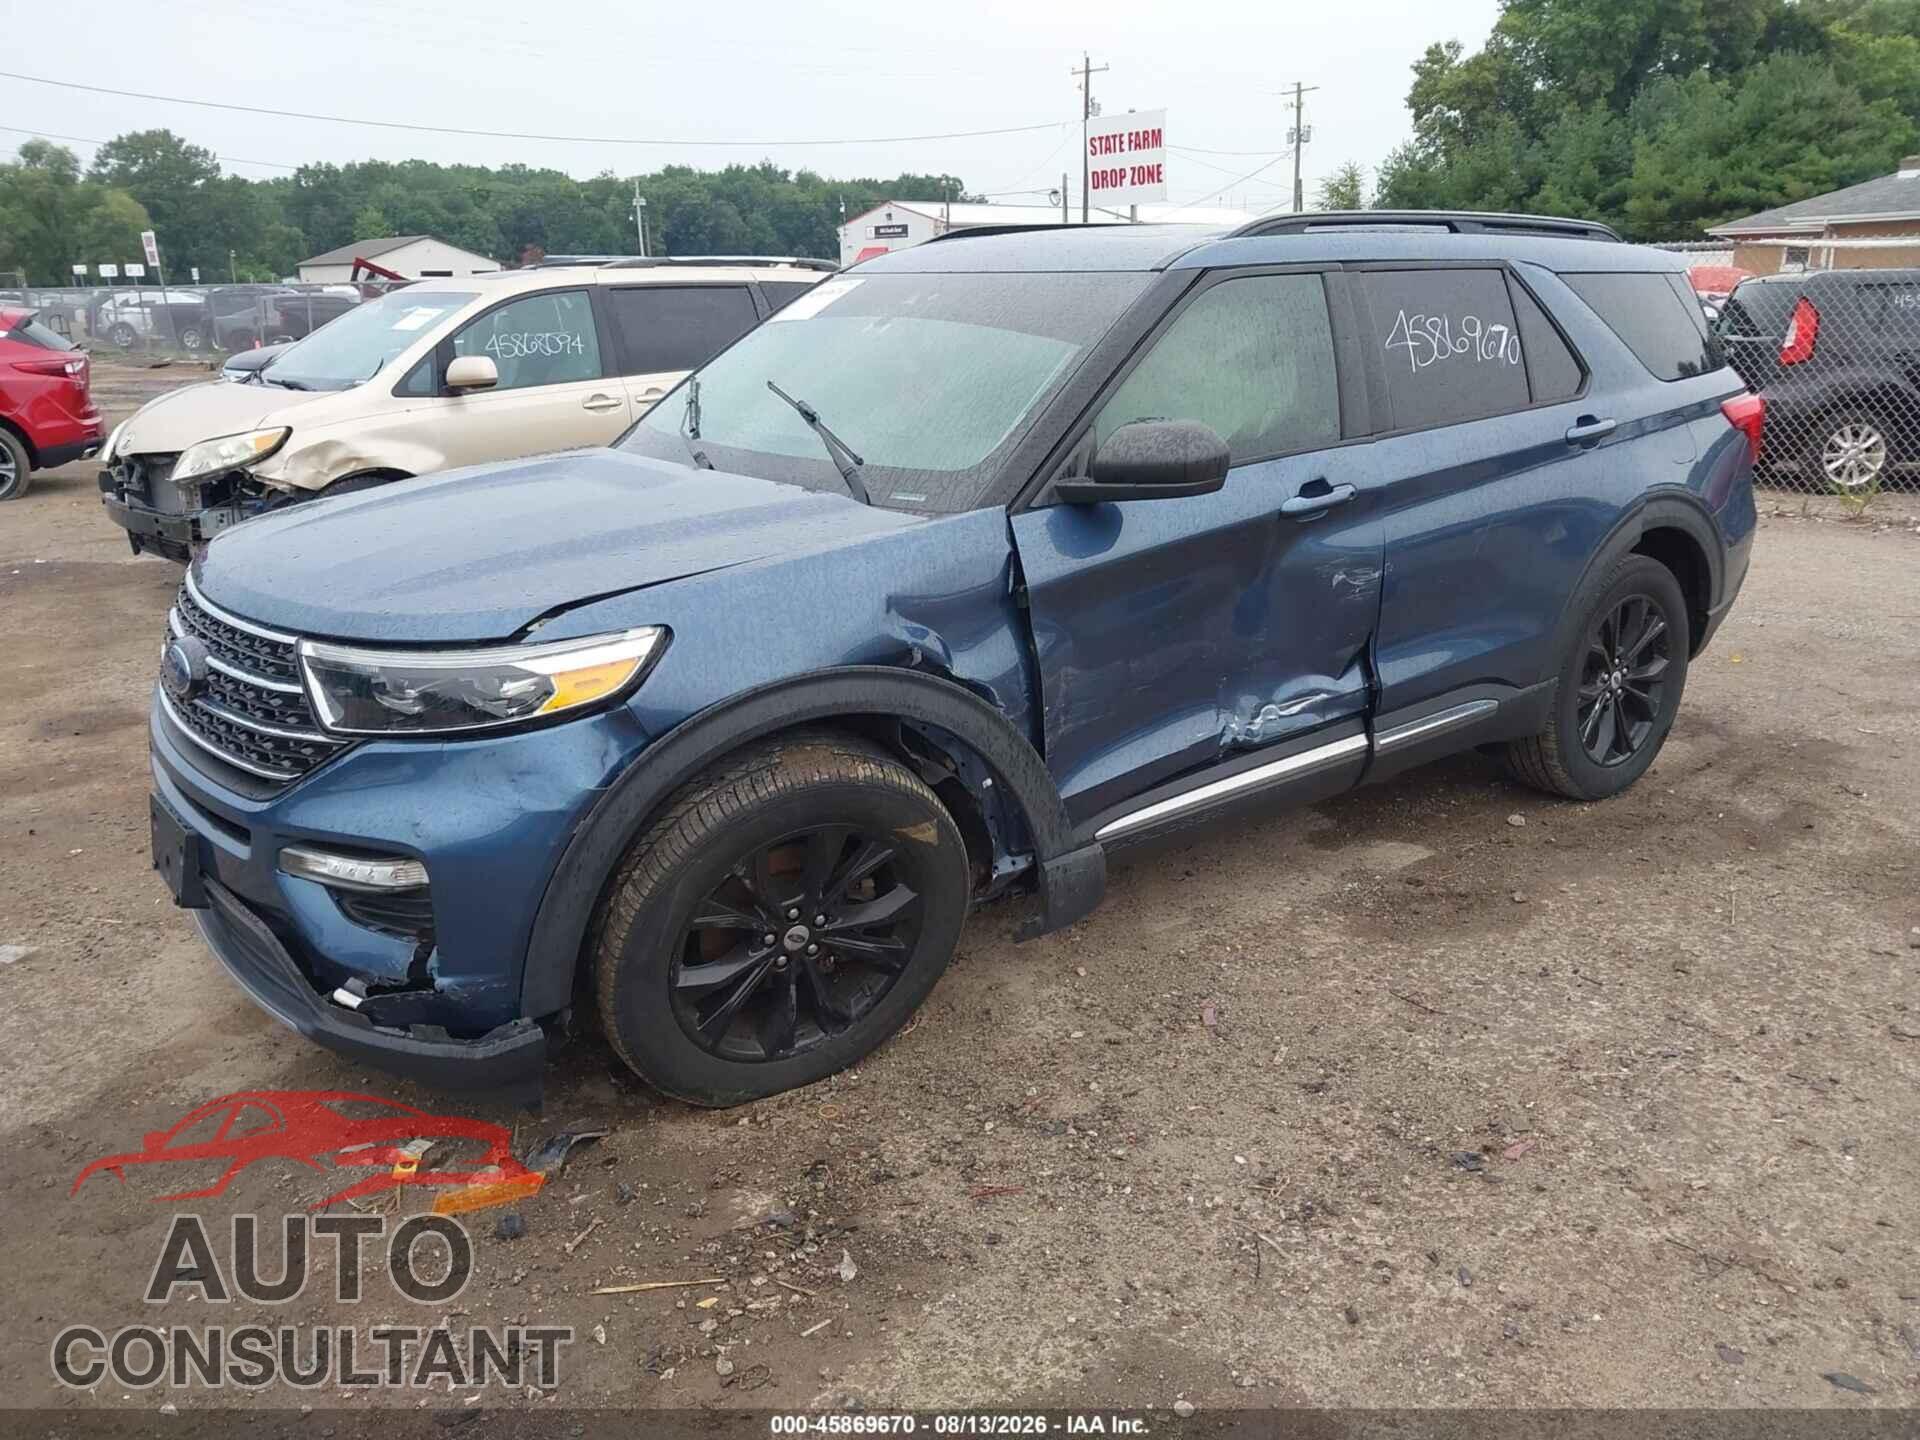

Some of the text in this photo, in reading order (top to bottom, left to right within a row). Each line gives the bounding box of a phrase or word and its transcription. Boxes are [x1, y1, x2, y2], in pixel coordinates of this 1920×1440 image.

[1089, 128, 1162, 156] STATE FARM
[1091, 163, 1163, 190] DROP ZONE
[1385, 309, 1519, 373] 45869670
